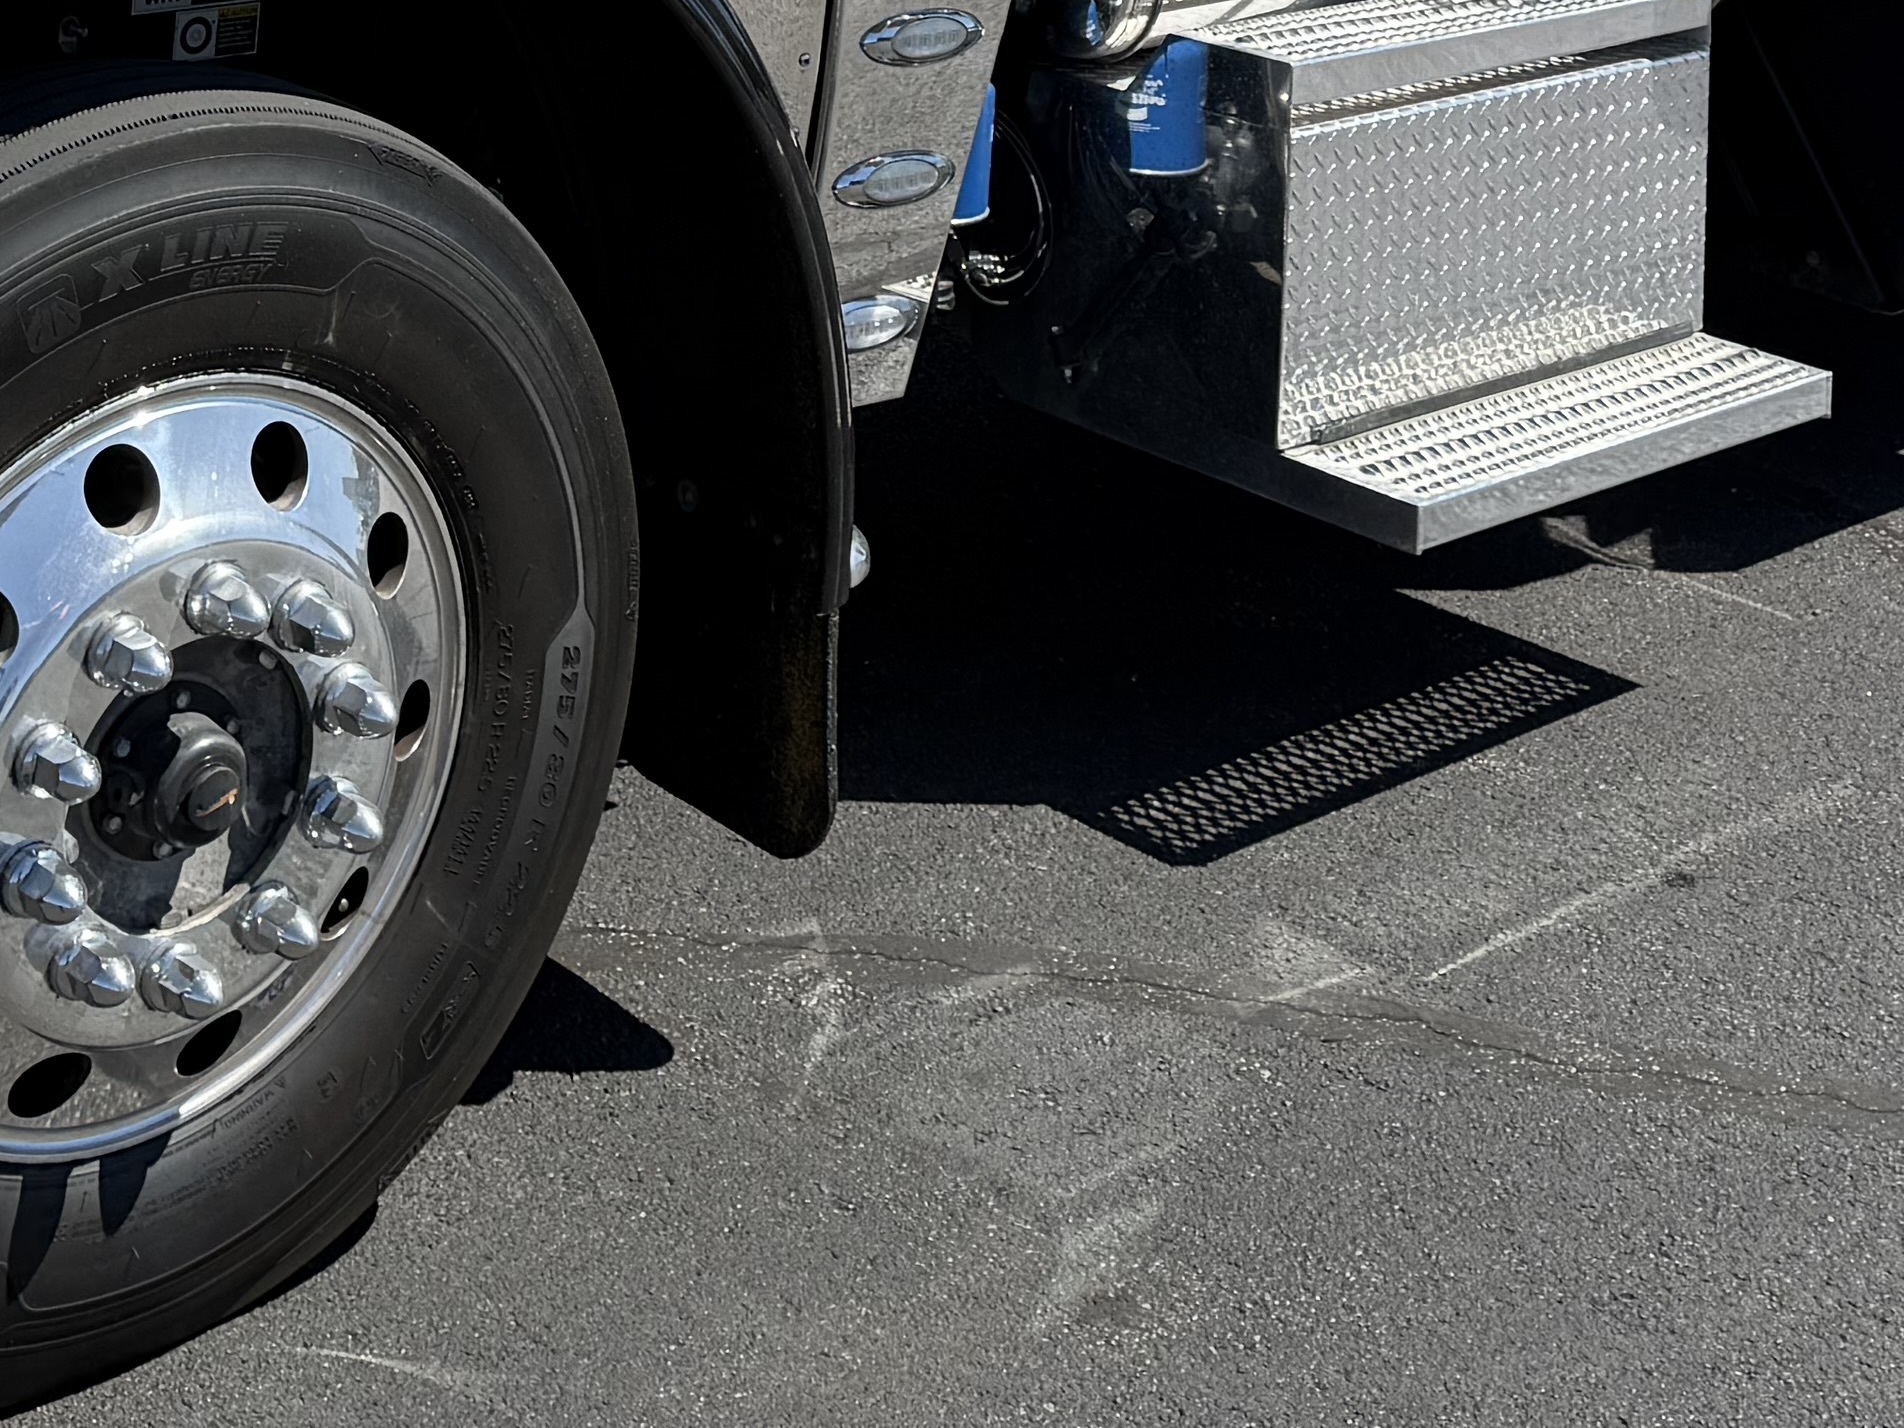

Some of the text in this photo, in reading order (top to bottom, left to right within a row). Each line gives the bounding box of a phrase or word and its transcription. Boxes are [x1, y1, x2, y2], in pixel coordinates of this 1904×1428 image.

[91, 221, 289, 303] X LINE
[189, 262, 272, 290] ENERGY
